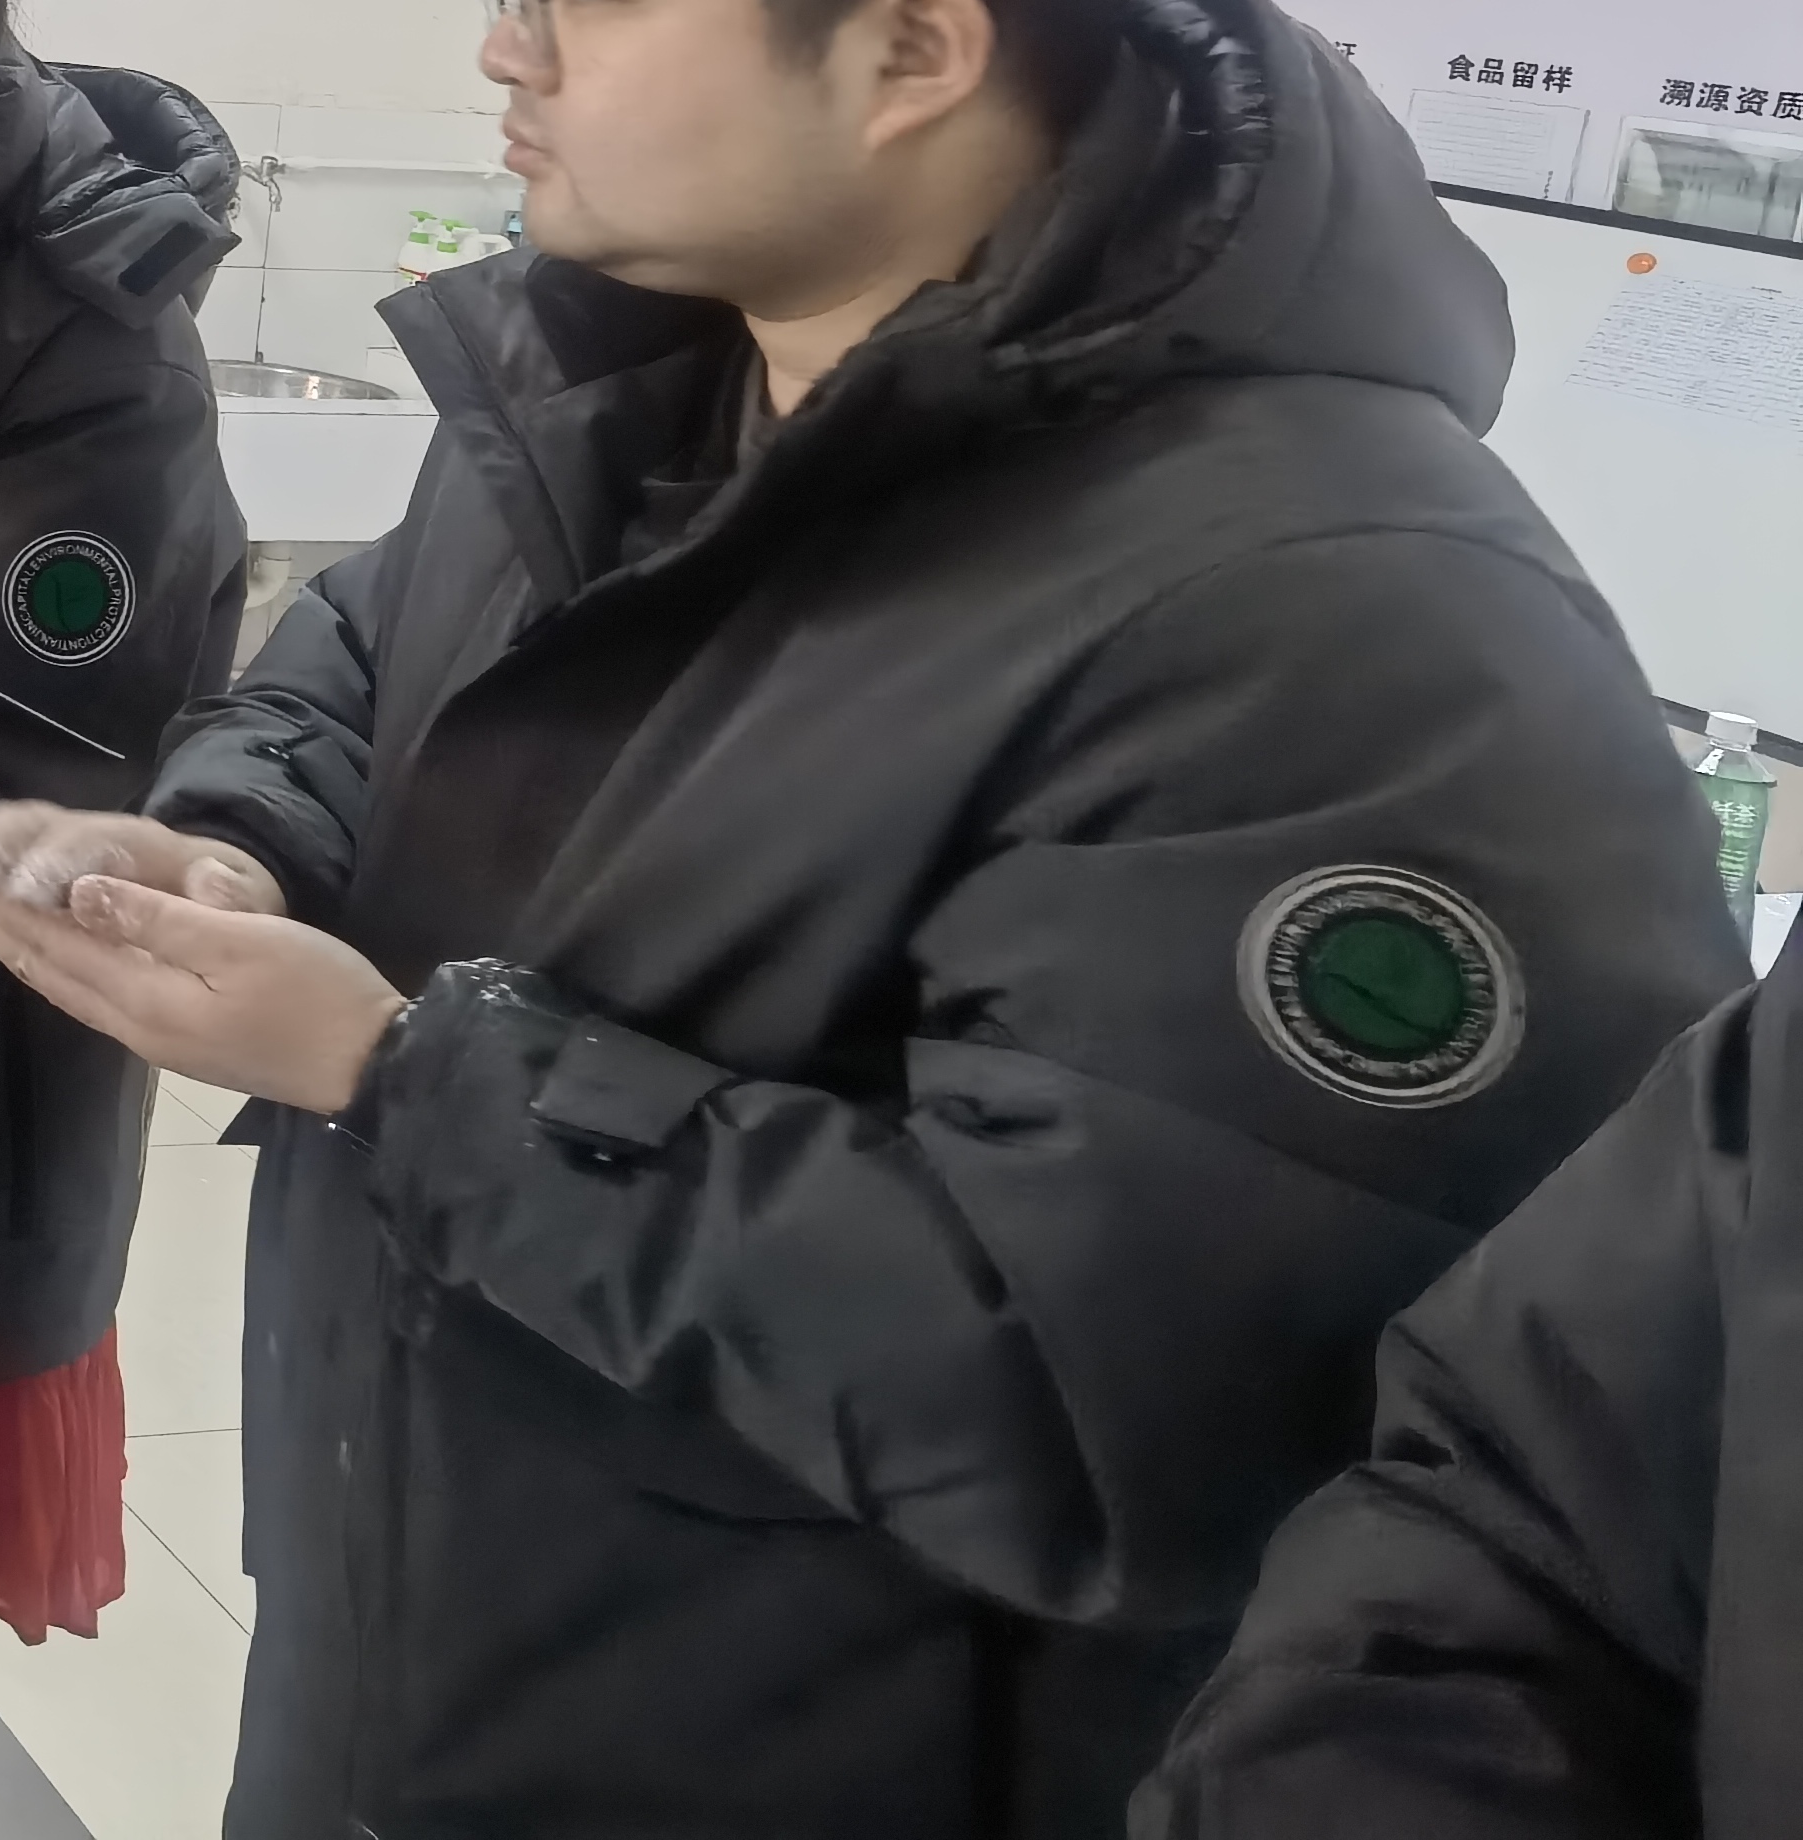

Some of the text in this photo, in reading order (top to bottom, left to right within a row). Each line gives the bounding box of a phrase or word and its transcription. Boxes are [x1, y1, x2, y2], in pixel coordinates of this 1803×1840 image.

[1446, 53, 1575, 94] 食品留样
[1658, 78, 1803, 122] 溯源资质
